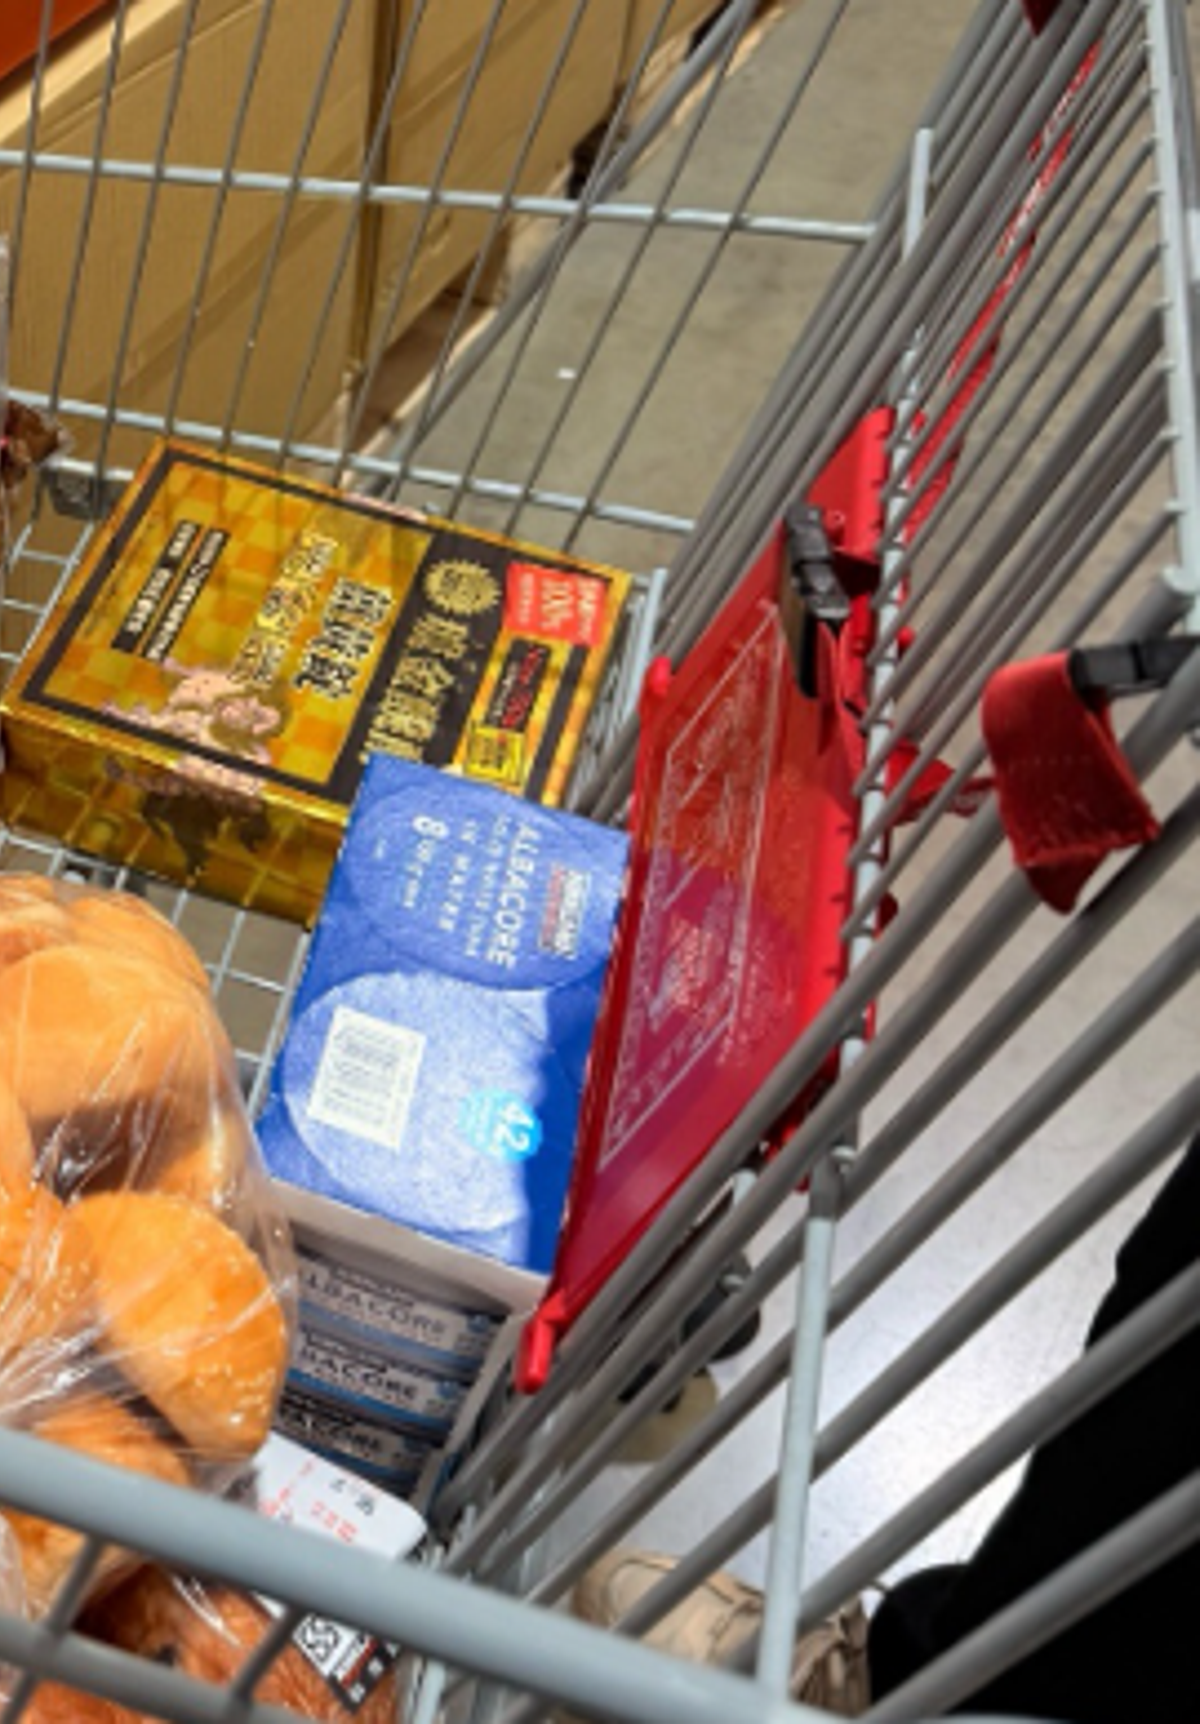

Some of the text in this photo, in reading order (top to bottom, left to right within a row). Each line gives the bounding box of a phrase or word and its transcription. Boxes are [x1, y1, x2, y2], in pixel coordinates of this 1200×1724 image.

[411, 815, 449, 841] 8
[485, 820, 542, 970] ALBACORE
[305, 1272, 450, 1337] LBACORE
